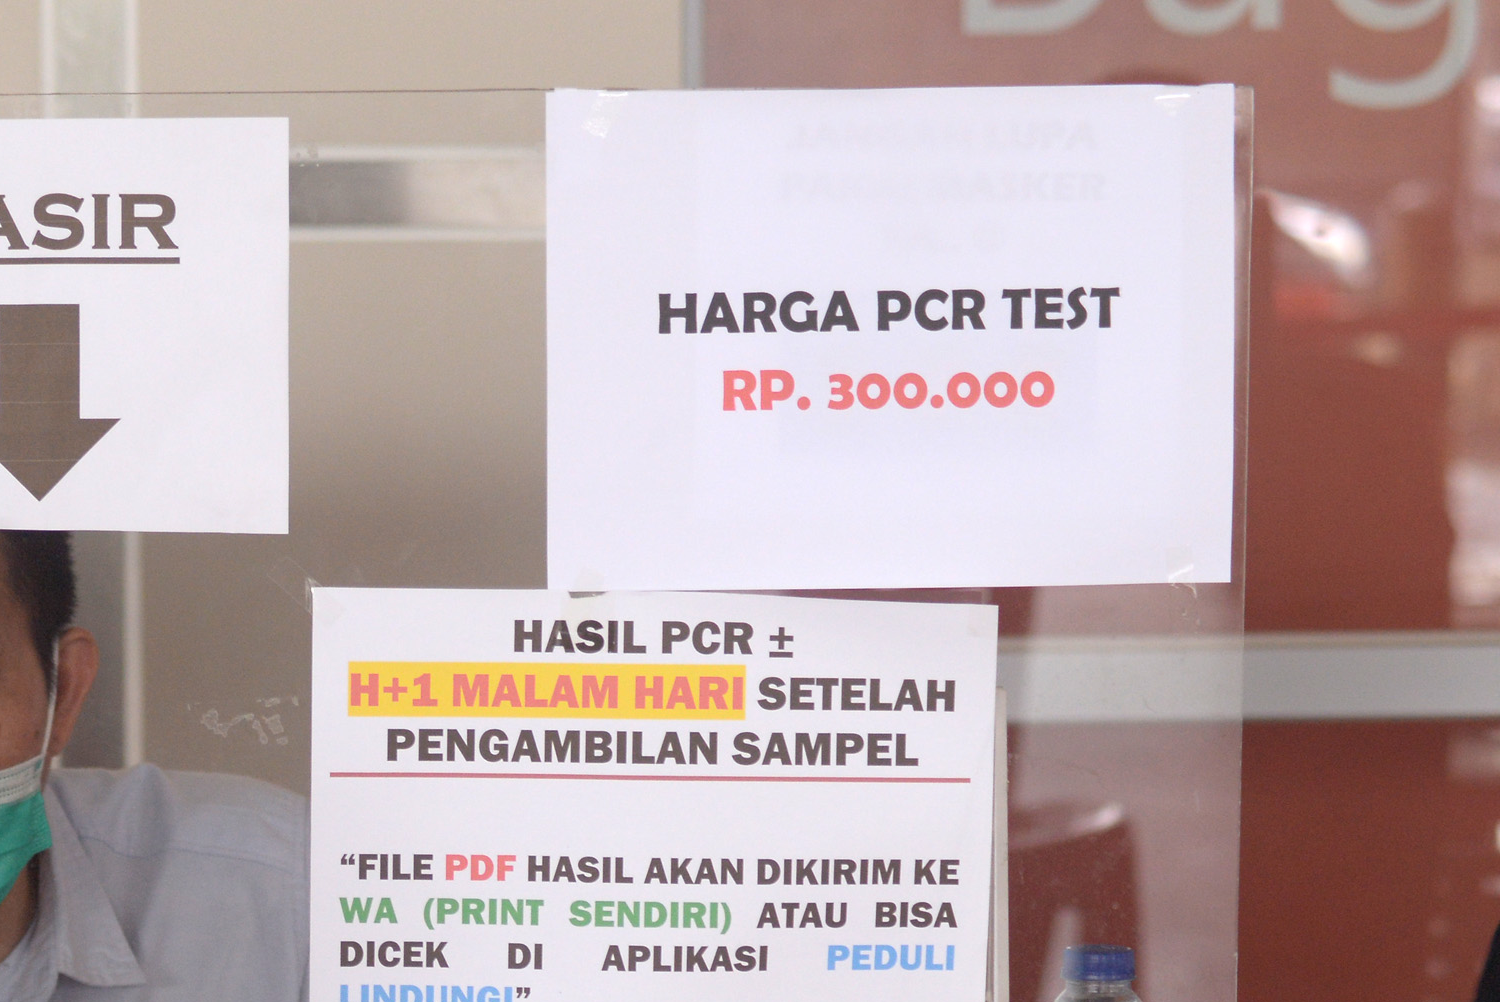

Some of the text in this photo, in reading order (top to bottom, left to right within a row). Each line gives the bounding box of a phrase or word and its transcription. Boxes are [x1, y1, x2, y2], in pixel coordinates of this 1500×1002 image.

[658, 286, 1121, 335] HARGA PCR TEST
[722, 369, 1056, 412] RP. 300.000
[513, 619, 647, 654] HASIL
[661, 620, 754, 655] PCR
[350, 672, 956, 713] H+1 MALAM HARI SETELAH
[386, 728, 919, 767] PENGAMBILAN SAMPEL
[445, 853, 517, 882] PDF
[527, 855, 634, 884] HASIL
[643, 857, 744, 885] AKAN
[756, 858, 902, 886] DIKIRIM
[913, 858, 960, 886] KE
[338, 896, 958, 935] WA (PRINT SENDIRI) ATAU BISA
[339, 940, 955, 973] DICEK DI APLIKASI PEDULI
